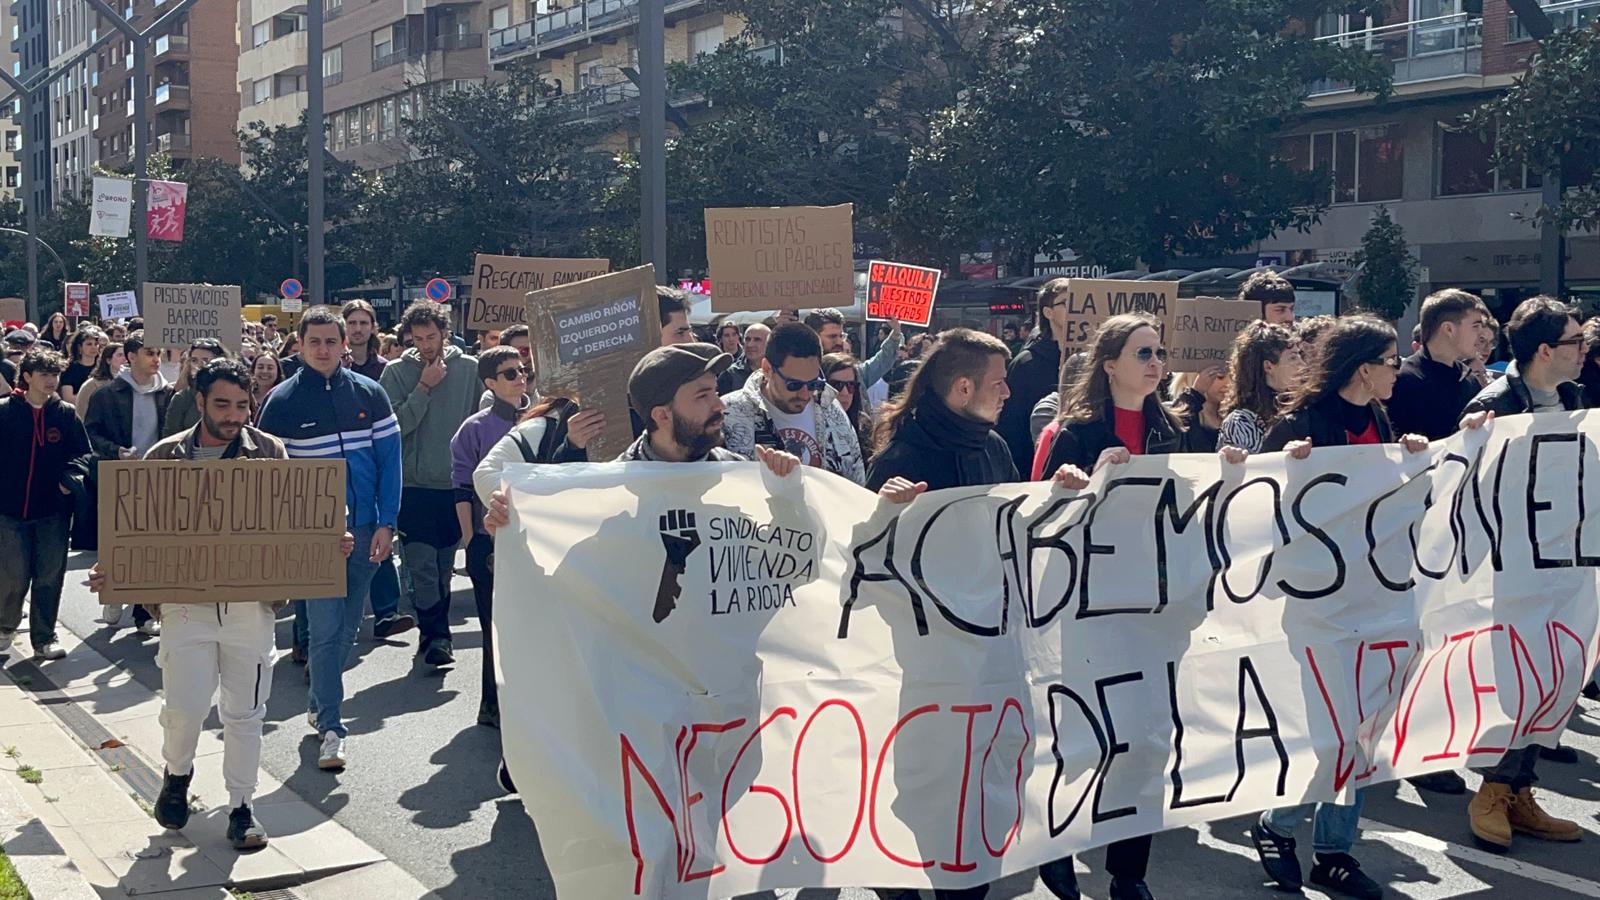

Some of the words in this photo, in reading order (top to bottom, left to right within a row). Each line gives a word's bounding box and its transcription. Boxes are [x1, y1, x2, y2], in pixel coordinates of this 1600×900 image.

[714, 216, 806, 246] RENTISTAS
[755, 242, 842, 273] CULPABLES
[478, 264, 544, 290] RESCATAN
[717, 281, 768, 298] GOBIERNO
[774, 277, 843, 297] RESPONSABLE
[871, 264, 885, 283] SE
[884, 266, 933, 289] ALQUILA
[154, 286, 187, 304] PISOS
[1068, 292, 1097, 314] LA
[167, 308, 218, 326] BARRIOS
[559, 310, 602, 328] CAMBIO
[561, 322, 618, 344] IZQUIERDO
[618, 315, 640, 329] POR
[1066, 320, 1090, 341] ES
[584, 333, 634, 353] DERECHA
[114, 467, 224, 532] RENTISTAS
[230, 466, 337, 532] CULPABLES
[709, 517, 813, 551] SINDICATO
[838, 473, 1348, 638] ACABEMOS
[1365, 438, 1511, 591] CON
[1527, 431, 1600, 569] EL
[112, 545, 209, 584] GOBIERNO
[213, 541, 337, 581] RESPONSABLE
[709, 545, 813, 583] VIVIENDA
[709, 589, 741, 615] LA
[747, 583, 796, 612] RIOJA
[620, 698, 1030, 895] NEGOCIO
[1047, 671, 1143, 838] DE
[1167, 656, 1289, 810] LA
[1306, 621, 1600, 792] VIVIEND
